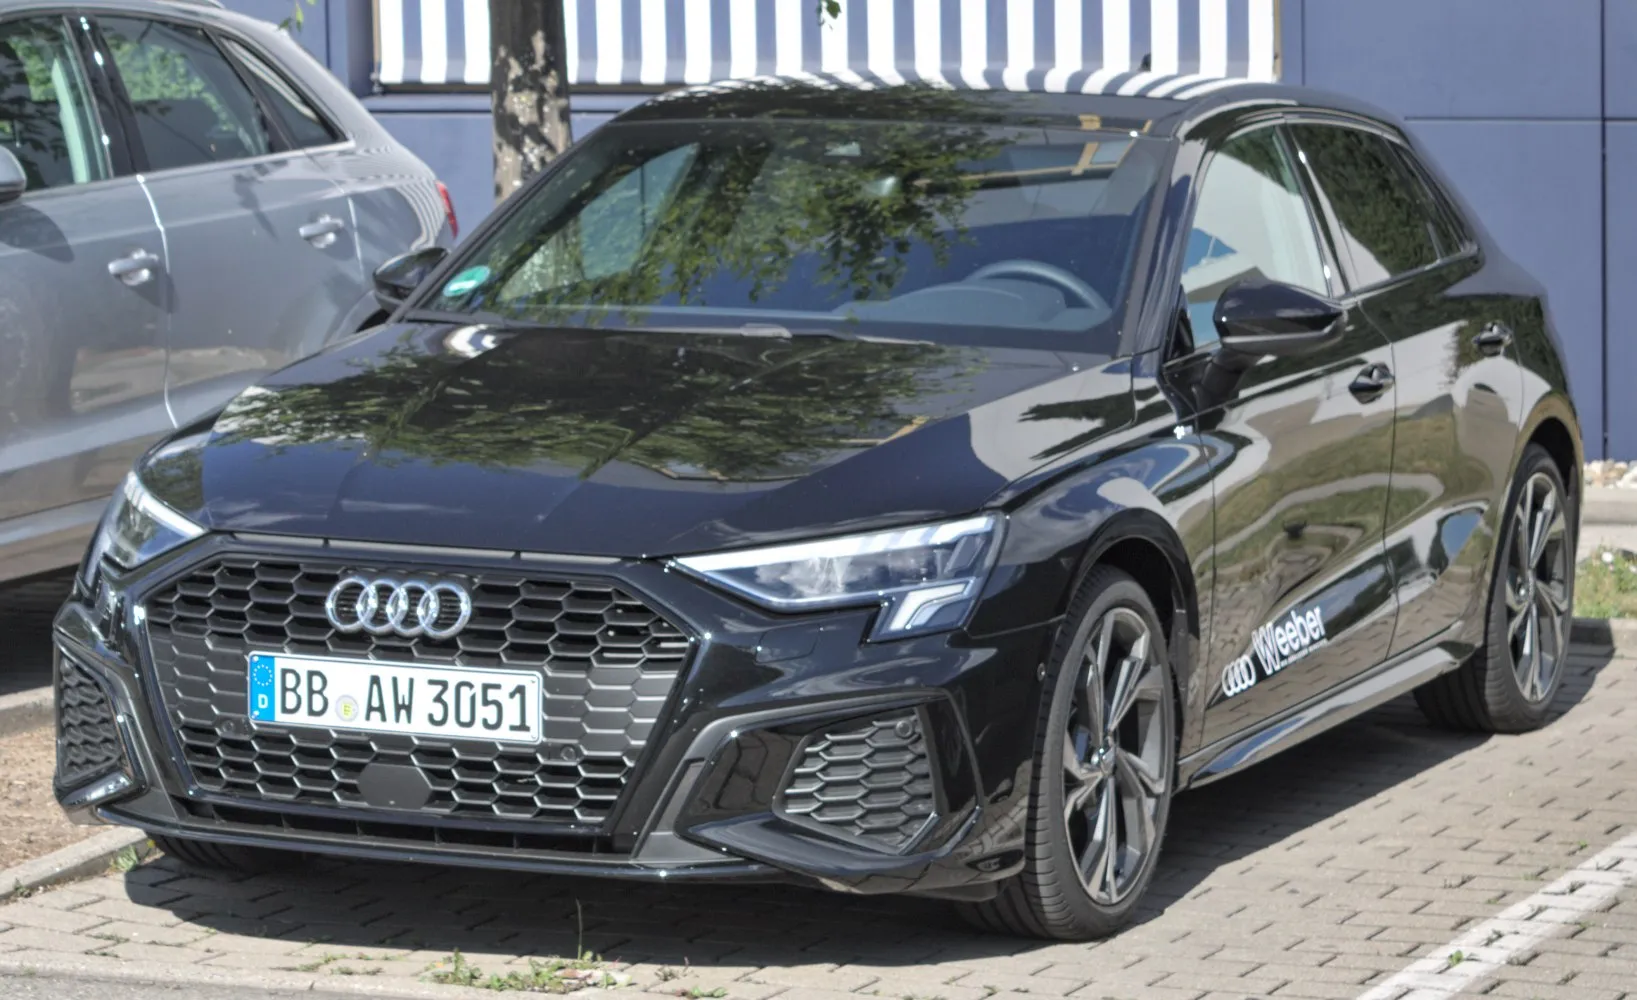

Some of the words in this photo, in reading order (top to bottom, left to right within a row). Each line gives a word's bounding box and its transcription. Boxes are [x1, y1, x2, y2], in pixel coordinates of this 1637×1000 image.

[1251, 606, 1325, 675] Weeber
[257, 693, 269, 709] D
[280, 668, 329, 717] BB
[365, 674, 414, 724] AW
[427, 679, 531, 732] 3051
